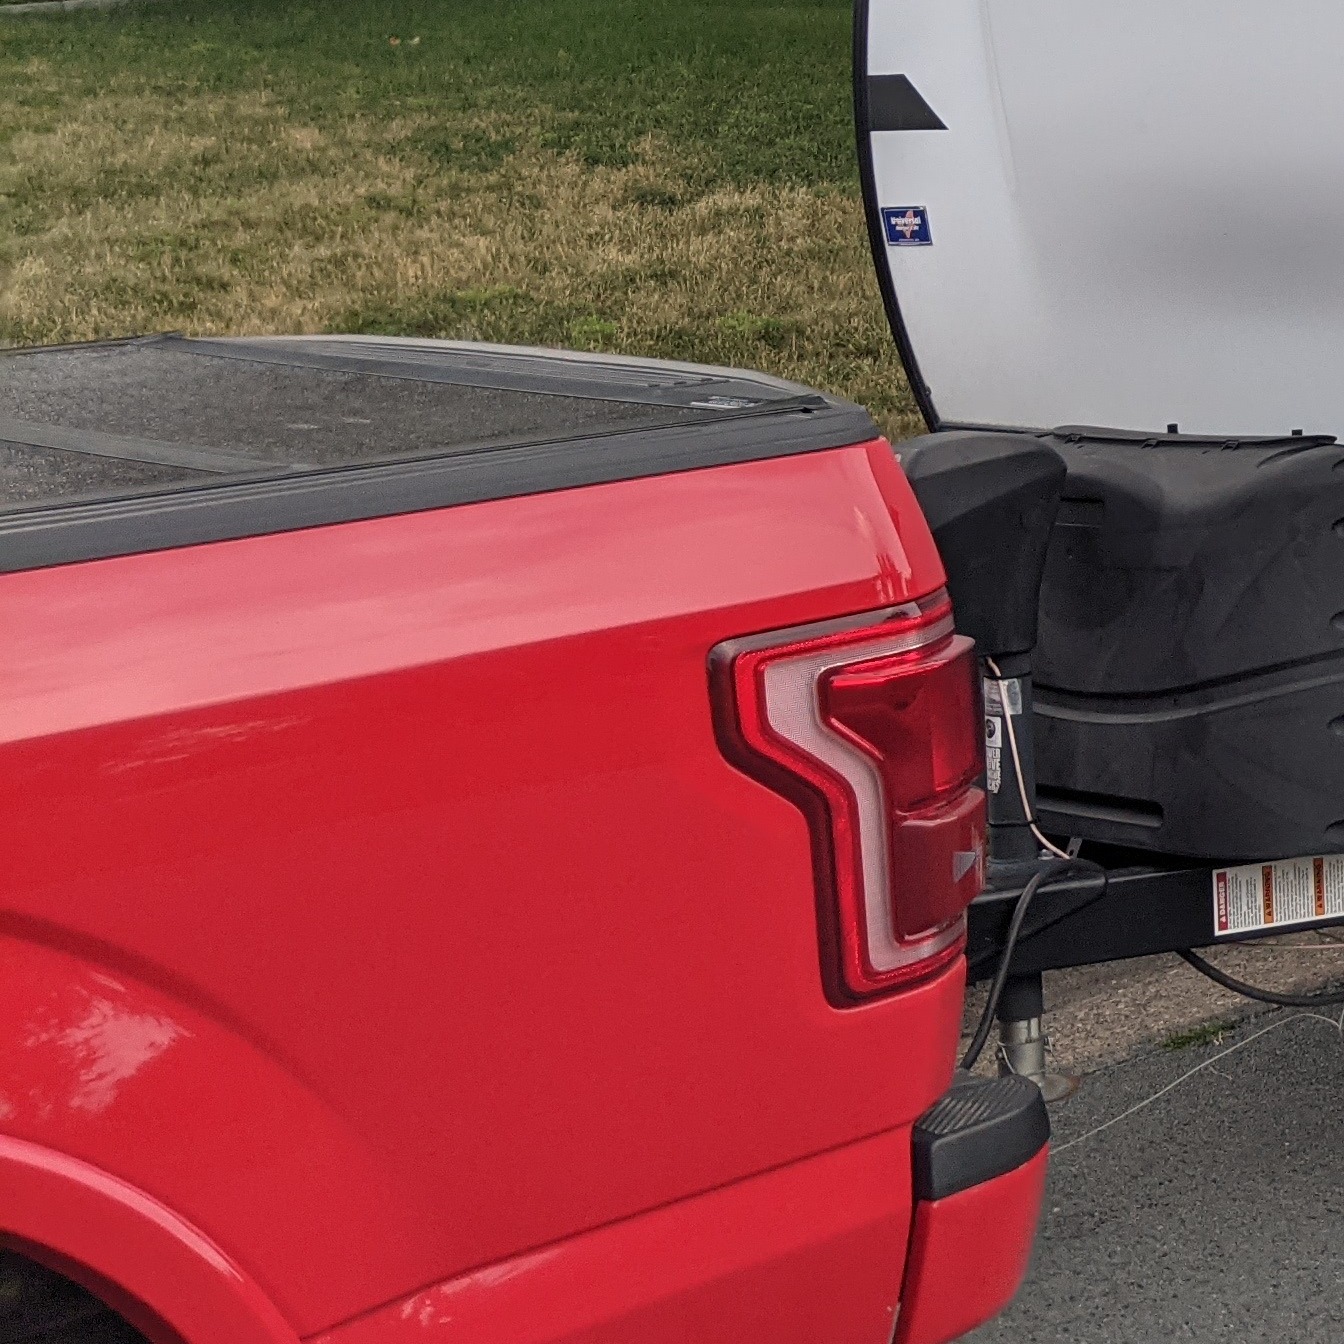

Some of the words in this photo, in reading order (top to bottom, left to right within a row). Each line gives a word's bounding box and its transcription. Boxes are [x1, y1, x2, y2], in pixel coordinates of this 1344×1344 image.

[1218, 881, 1226, 916] DANGER
[1264, 871, 1272, 911] WARNING
[1314, 862, 1323, 903] WARNING
